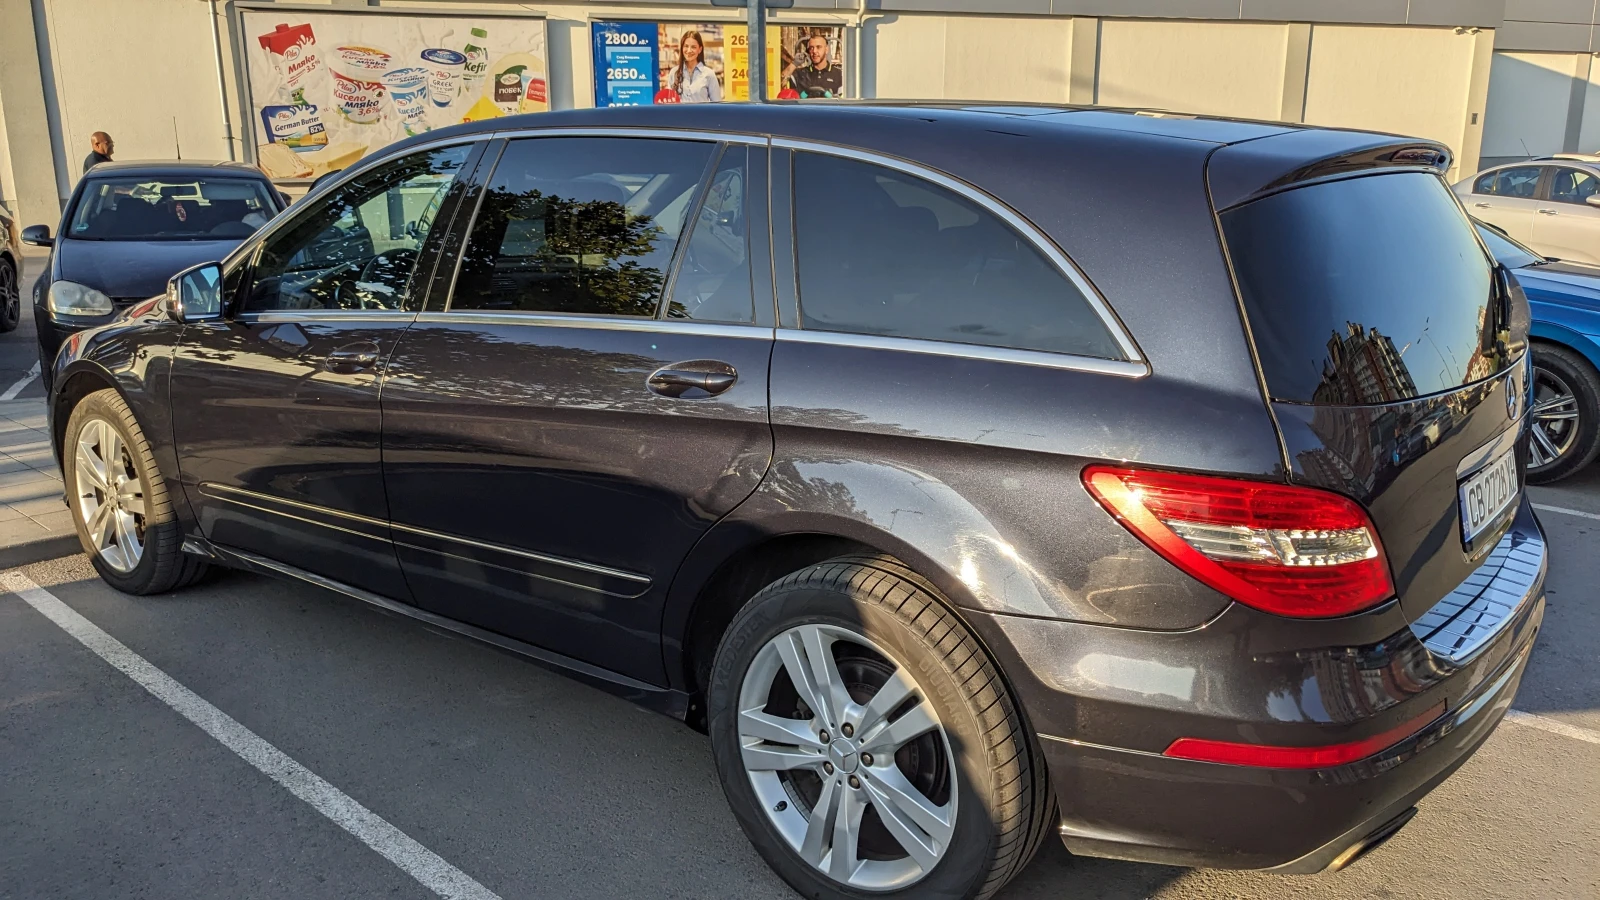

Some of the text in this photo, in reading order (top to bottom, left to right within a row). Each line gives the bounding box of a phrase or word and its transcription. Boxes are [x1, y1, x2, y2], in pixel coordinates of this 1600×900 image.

[605, 33, 638, 45] 2800
[731, 35, 748, 46] 26
[288, 55, 315, 74] Мляко
[464, 62, 487, 74] Kefir
[607, 68, 638, 79] 2650
[731, 69, 748, 79] 24
[336, 79, 353, 92] Pilos
[432, 80, 453, 88] GREEK
[334, 88, 367, 102] Кисело
[345, 100, 379, 108] мляко
[357, 106, 380, 116] 3,6%
[275, 116, 319, 132] German Butter
[310, 125, 324, 133] 82%
[1468, 482, 1485, 528] CB
[1484, 463, 1507, 516] 2728
